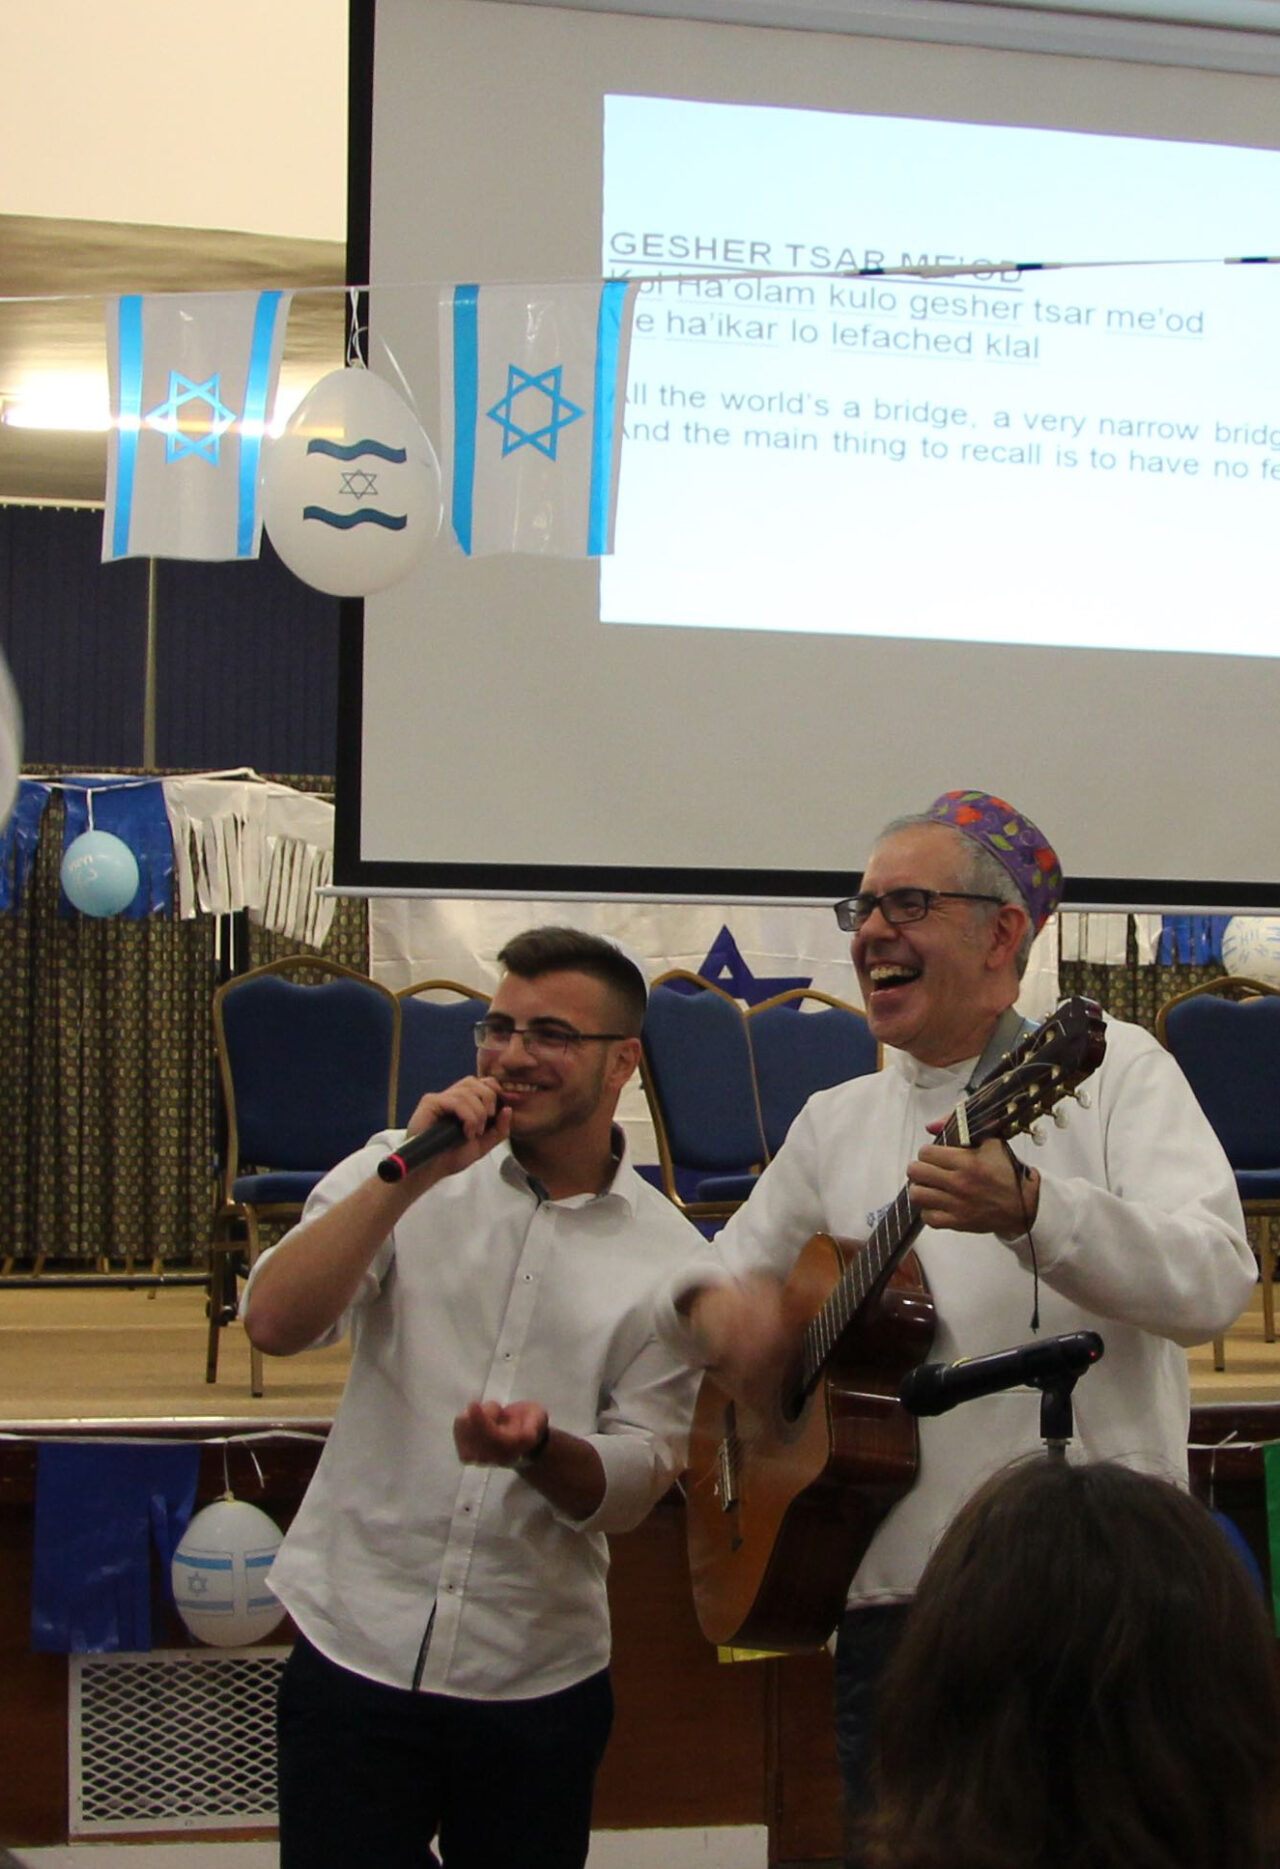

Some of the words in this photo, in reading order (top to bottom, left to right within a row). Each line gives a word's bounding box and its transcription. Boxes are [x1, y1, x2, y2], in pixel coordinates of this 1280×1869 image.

[610, 231, 772, 266] GESHER
[785, 243, 885, 272] TSAR
[677, 272, 816, 305] Ha'olam
[829, 283, 897, 310] kulo
[910, 293, 1025, 320] gesher
[1034, 299, 1097, 326] tsar
[1106, 307, 1204, 334] me'od
[667, 310, 779, 341] ha'ikar
[792, 317, 819, 344] lo
[832, 322, 972, 354] lefached
[986, 332, 1040, 359] klal
[624, 381, 647, 405] ll
[659, 383, 707, 409] the
[721, 390, 830, 417] world's
[843, 400, 861, 419] a
[993, 410, 1011, 428] a
[1023, 412, 1087, 438] very
[1098, 417, 1200, 441] narrow
[683, 421, 731, 445] the
[744, 427, 818, 451] main
[833, 431, 907, 462] thing
[922, 436, 949, 459] to
[961, 442, 1041, 465] recall
[1055, 444, 1079, 468] is
[1090, 447, 1117, 470] to
[1129, 449, 1200, 476] have
[1213, 458, 1249, 479] no
